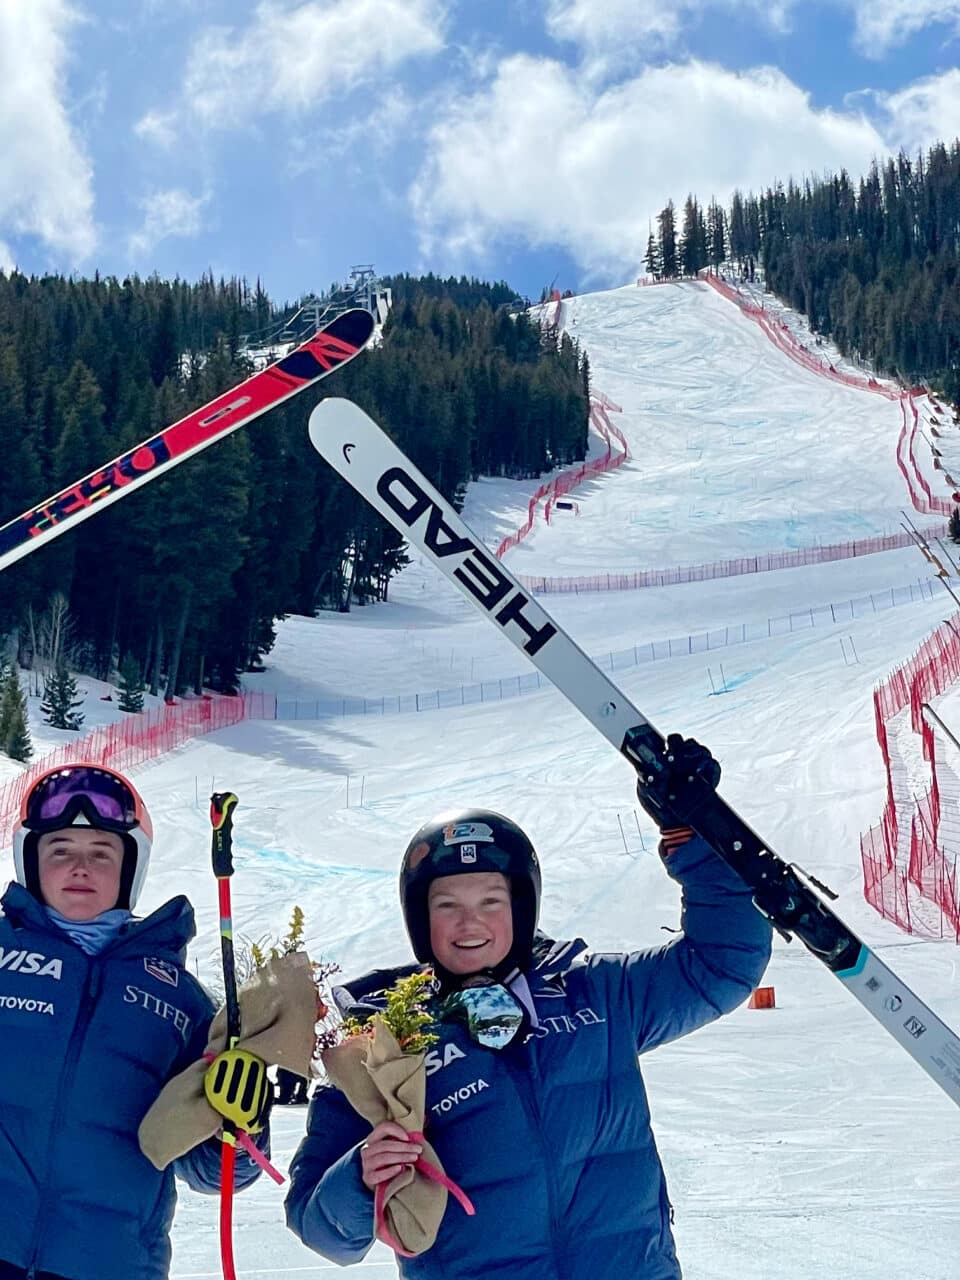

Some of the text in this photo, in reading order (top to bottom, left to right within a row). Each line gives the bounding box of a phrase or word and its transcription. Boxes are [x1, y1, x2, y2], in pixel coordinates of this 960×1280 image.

[376, 465, 557, 656] HEAD
[0, 995, 54, 1016] TOYOTA
[123, 985, 189, 1041] STIFEL
[425, 1043, 467, 1076] SA
[432, 1078, 489, 1117] TOYOTA
